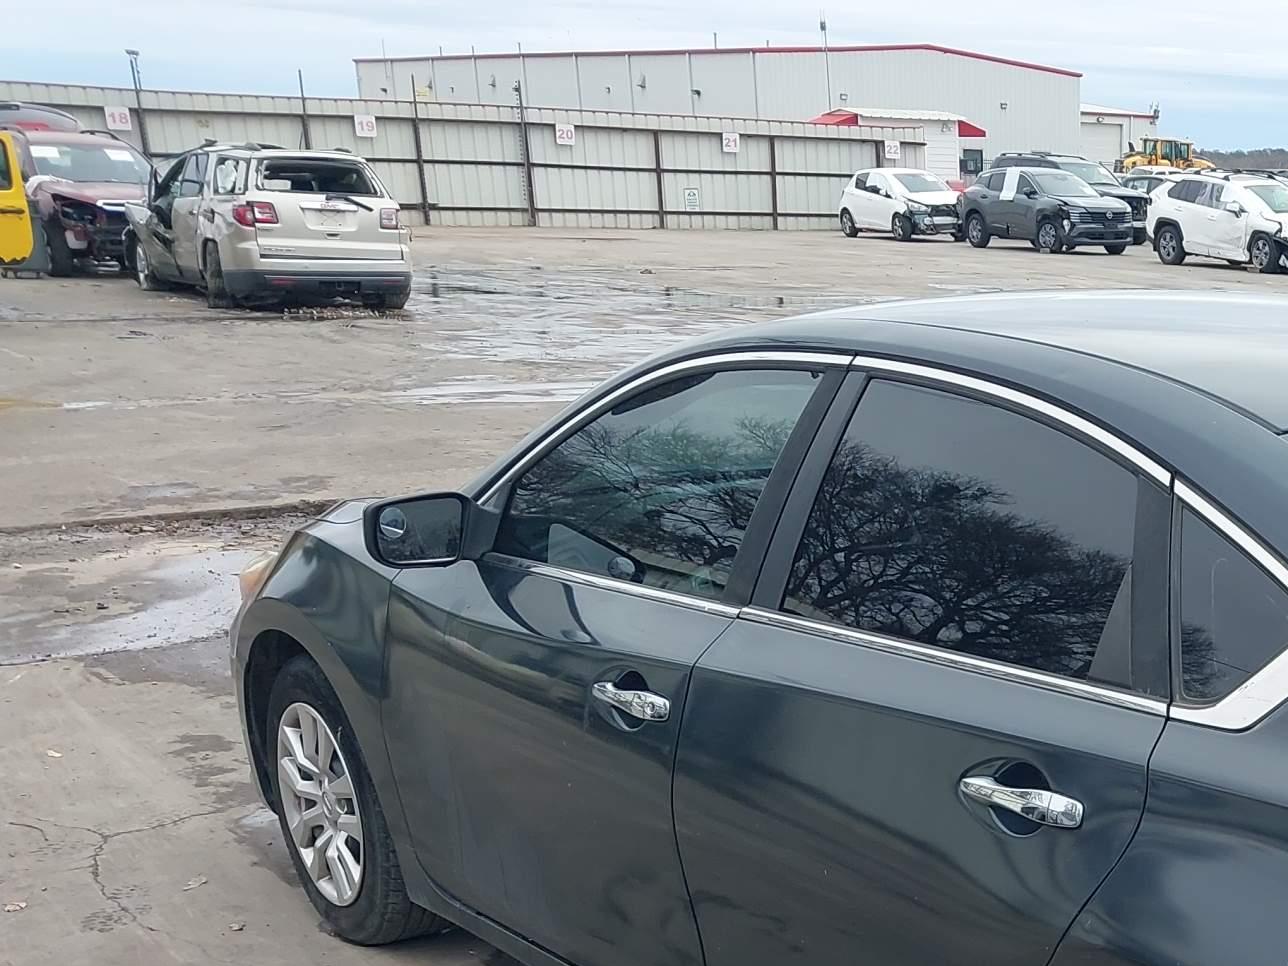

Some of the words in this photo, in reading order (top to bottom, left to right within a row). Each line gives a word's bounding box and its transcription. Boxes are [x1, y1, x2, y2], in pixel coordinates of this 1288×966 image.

[108, 111, 129, 125] 18
[357, 119, 375, 132] 19
[557, 128, 573, 140] 20
[724, 137, 737, 148] 21
[886, 144, 899, 155] 22
